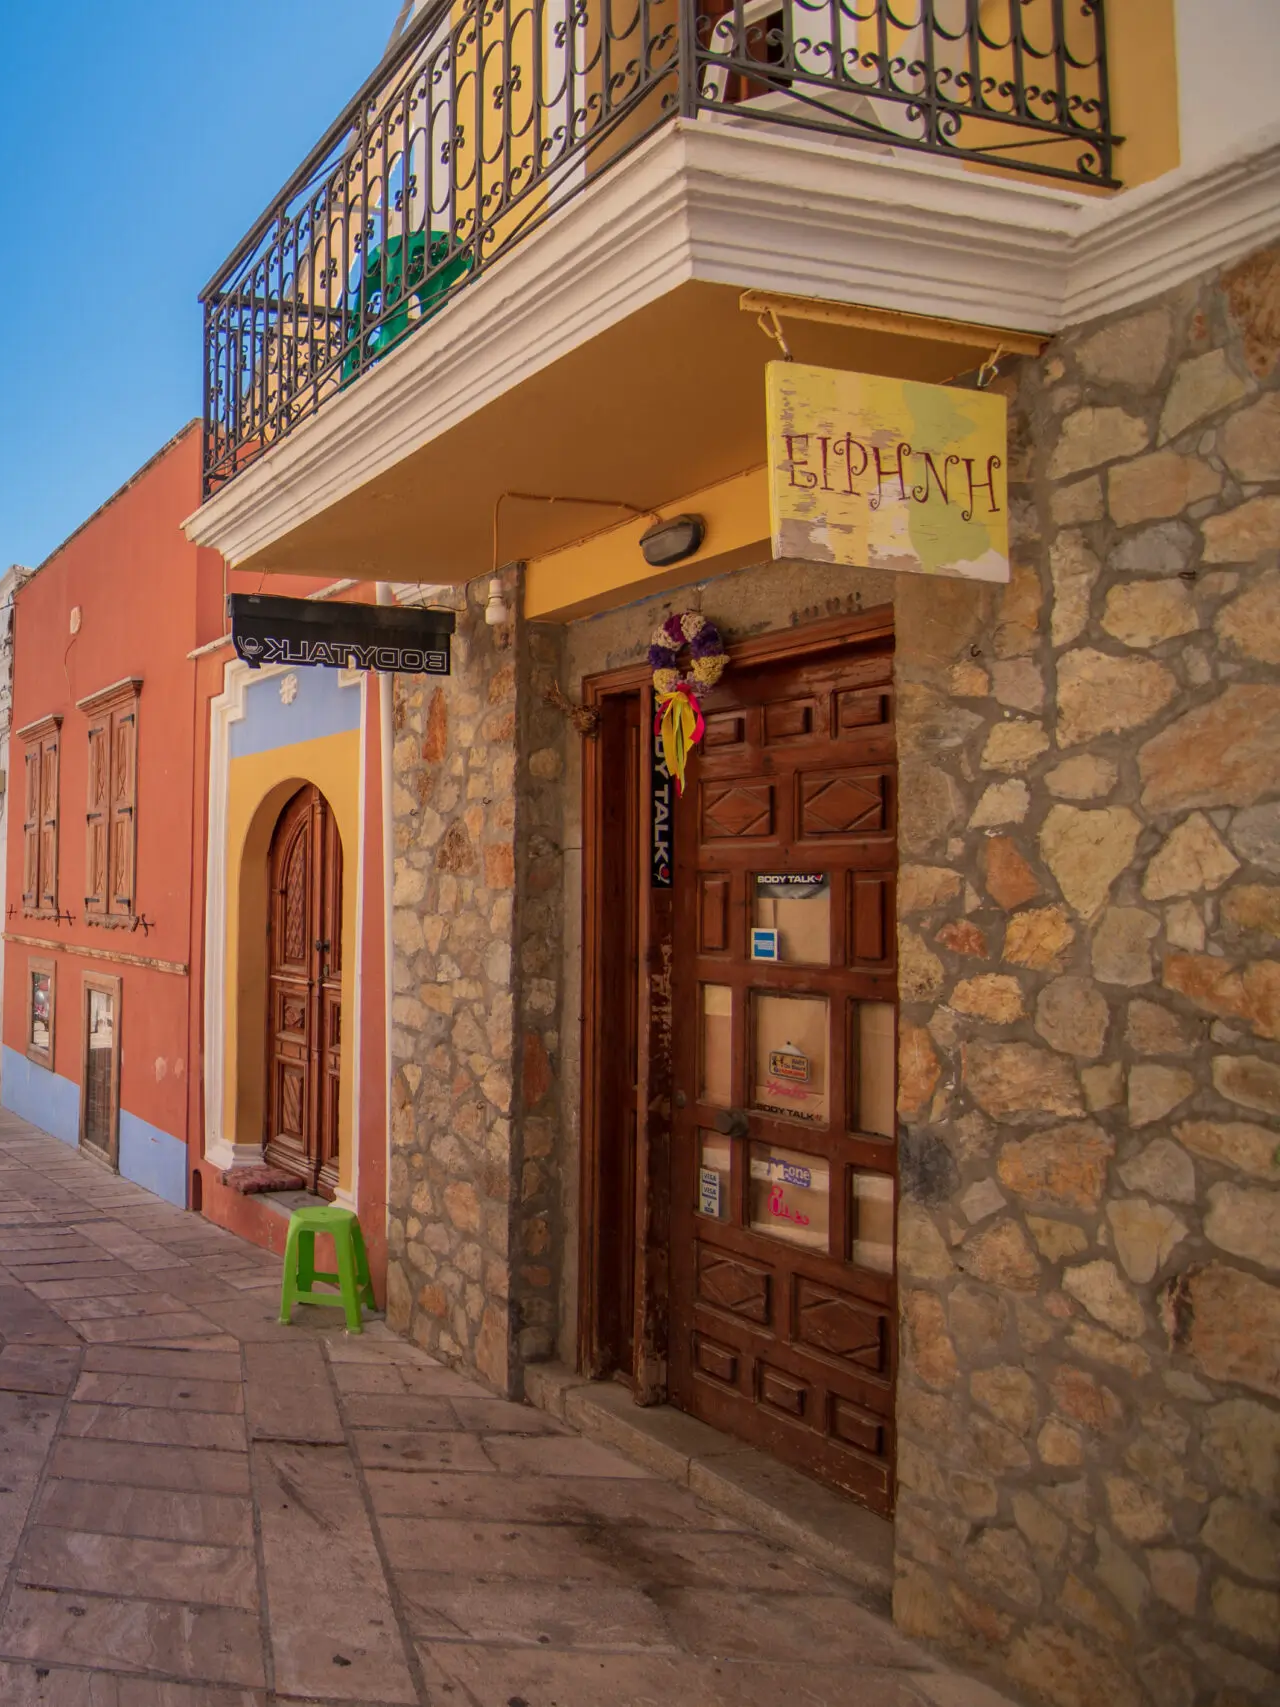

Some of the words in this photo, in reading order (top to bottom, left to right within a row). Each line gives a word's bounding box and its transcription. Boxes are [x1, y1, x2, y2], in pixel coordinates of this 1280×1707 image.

[654, 784, 669, 864] TALK
[757, 875, 786, 884] BODY
[787, 875, 816, 884] TALK
[786, 1108, 814, 1121] TALK
